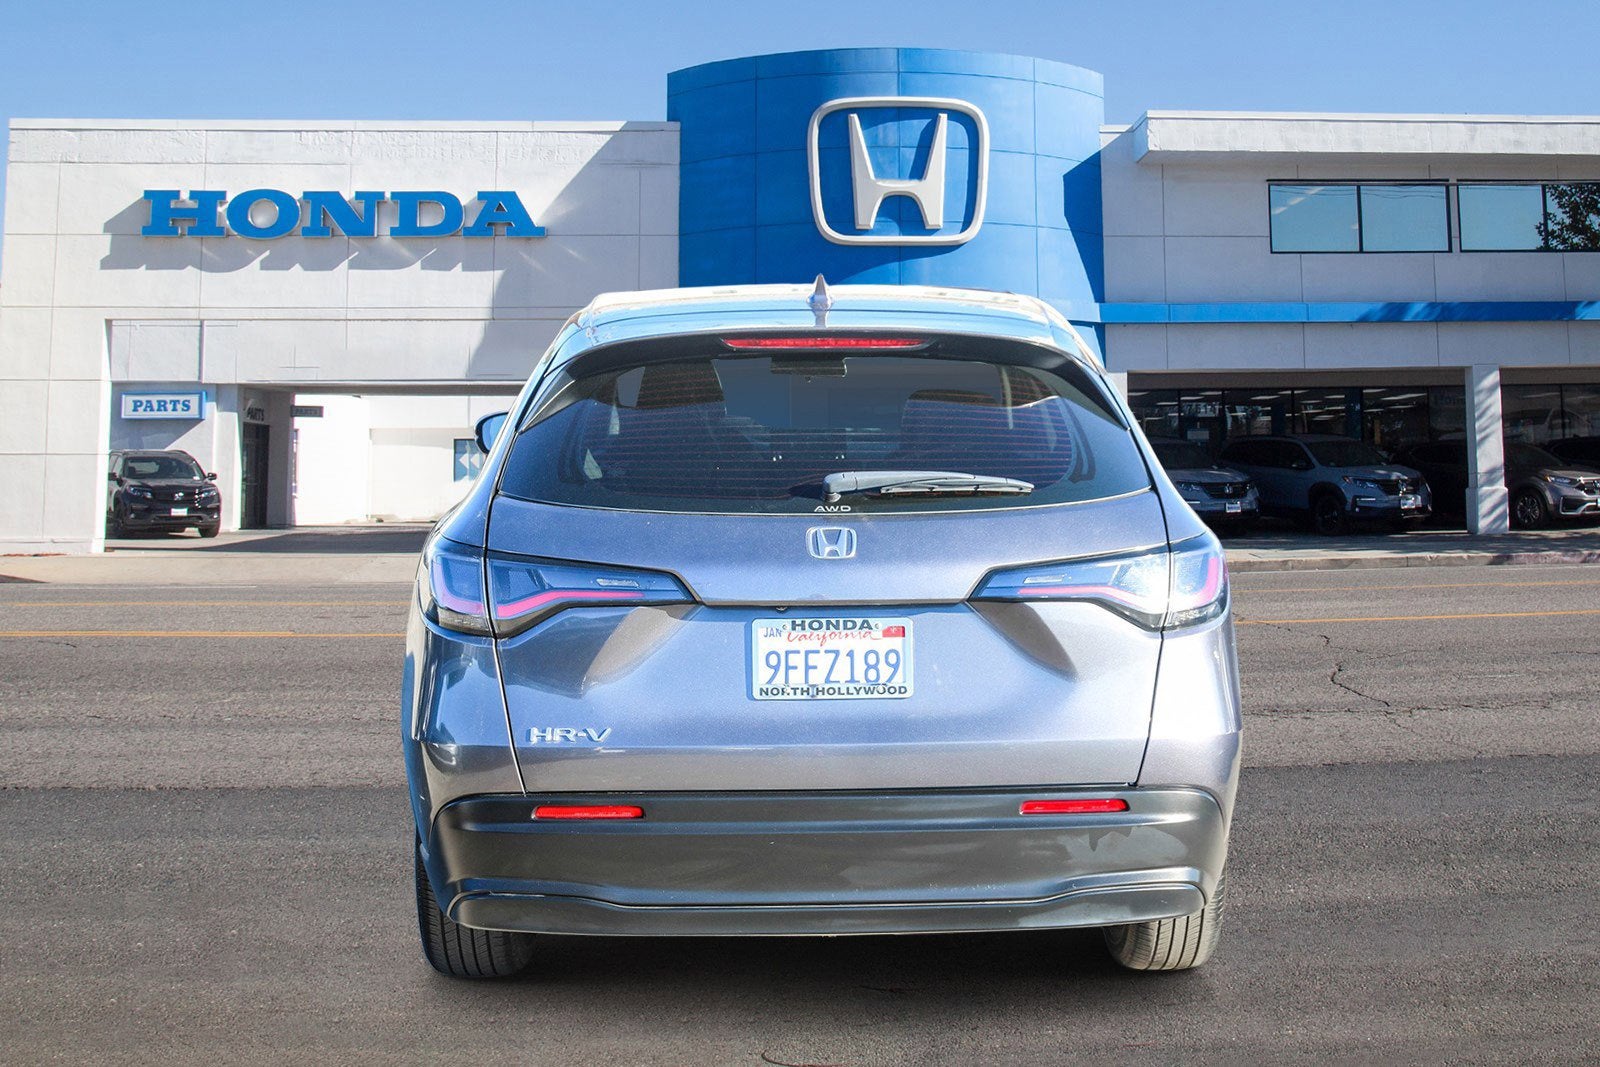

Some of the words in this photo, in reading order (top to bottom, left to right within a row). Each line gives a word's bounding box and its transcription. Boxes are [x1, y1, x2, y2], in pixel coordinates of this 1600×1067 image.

[141, 188, 547, 239] HONDA
[132, 399, 191, 413] PARTS
[791, 619, 873, 631] HONDA
[763, 628, 782, 637] JAN
[765, 649, 901, 684] 9FFZ189
[759, 686, 810, 696] NORTH
[815, 685, 908, 696] HOLLYWOOD
[528, 727, 612, 743] HR-V
